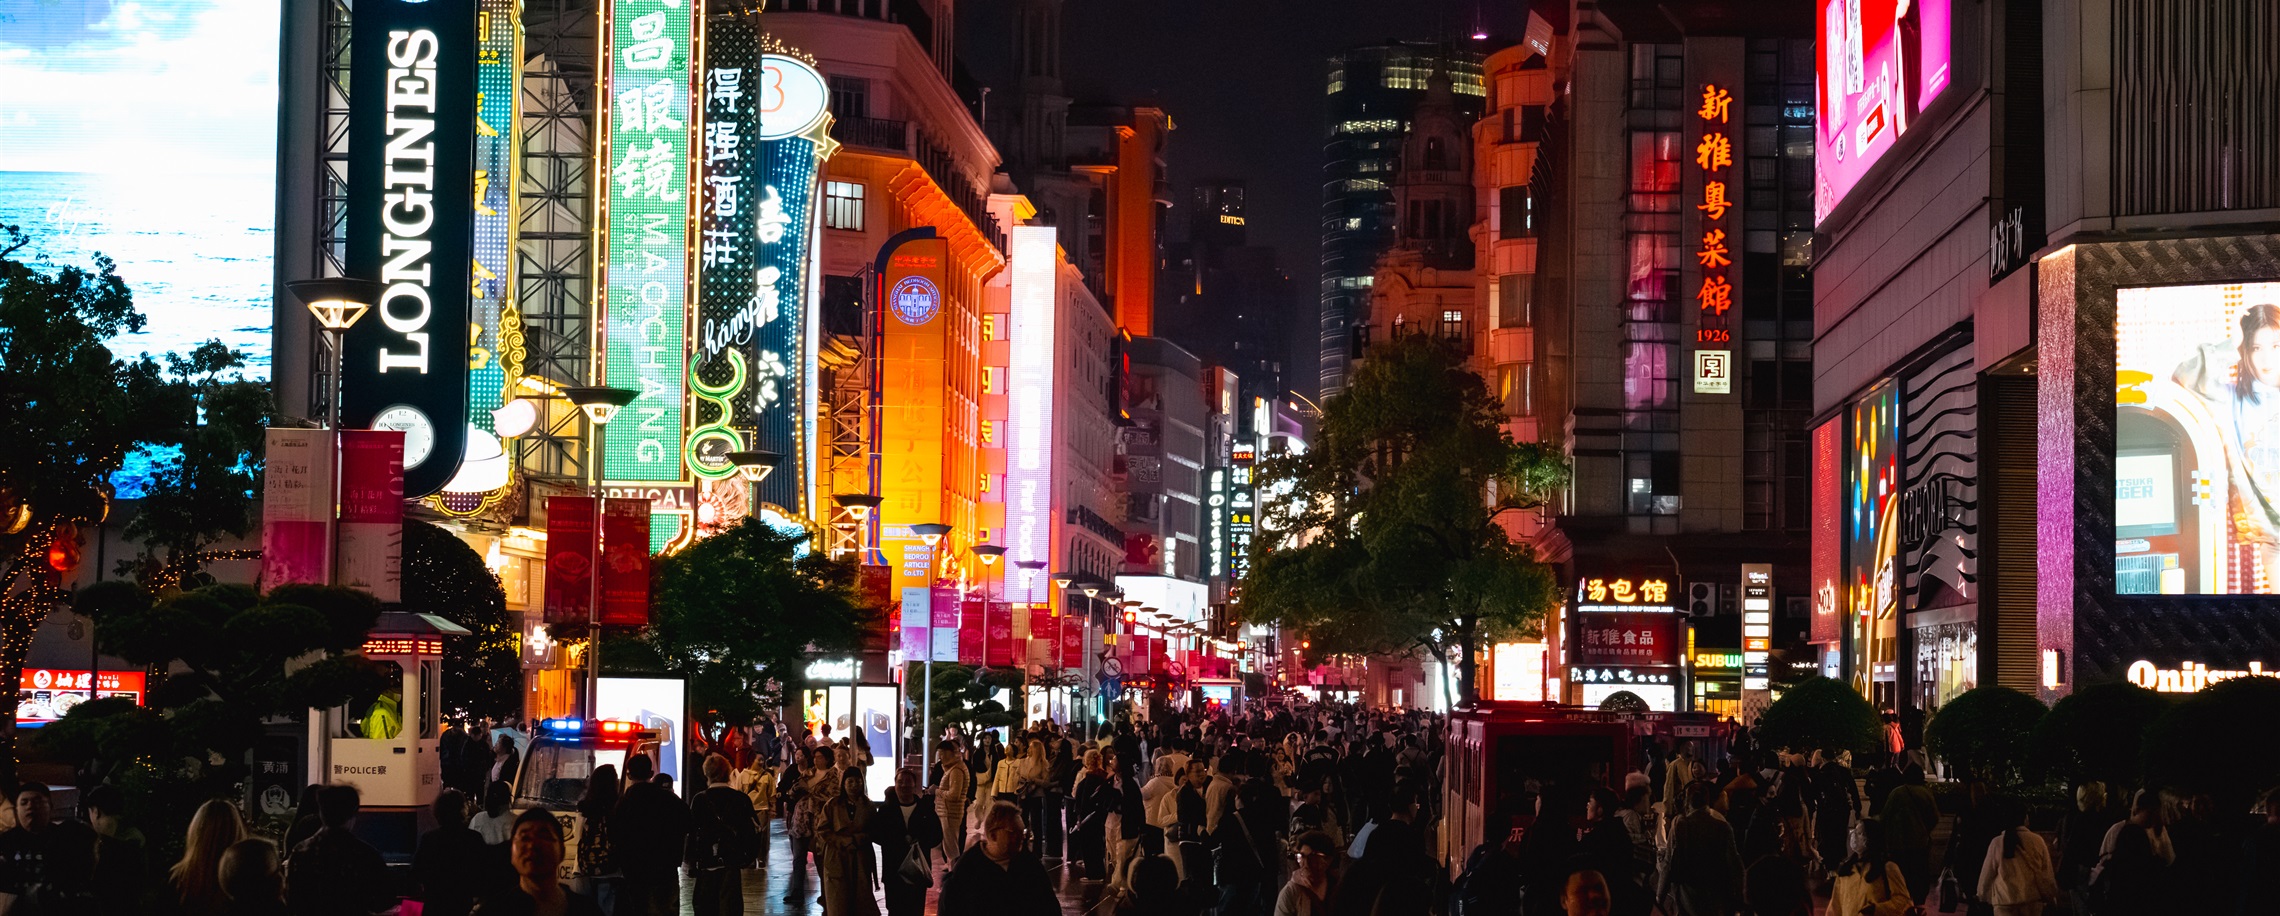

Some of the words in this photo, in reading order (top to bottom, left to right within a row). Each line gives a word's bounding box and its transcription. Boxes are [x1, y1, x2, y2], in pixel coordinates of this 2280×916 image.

[612, 0, 682, 201] 昌眼镜
[379, 29, 440, 375] LONGINES
[1220, 214, 1245, 226] EDITION
[636, 213, 669, 464] MAOCHANG
[1697, 329, 1730, 342] 1926
[591, 488, 690, 507] PTICAL
[1587, 578, 1668, 603] 汤包馆
[1587, 629, 1654, 646] 新雅食品
